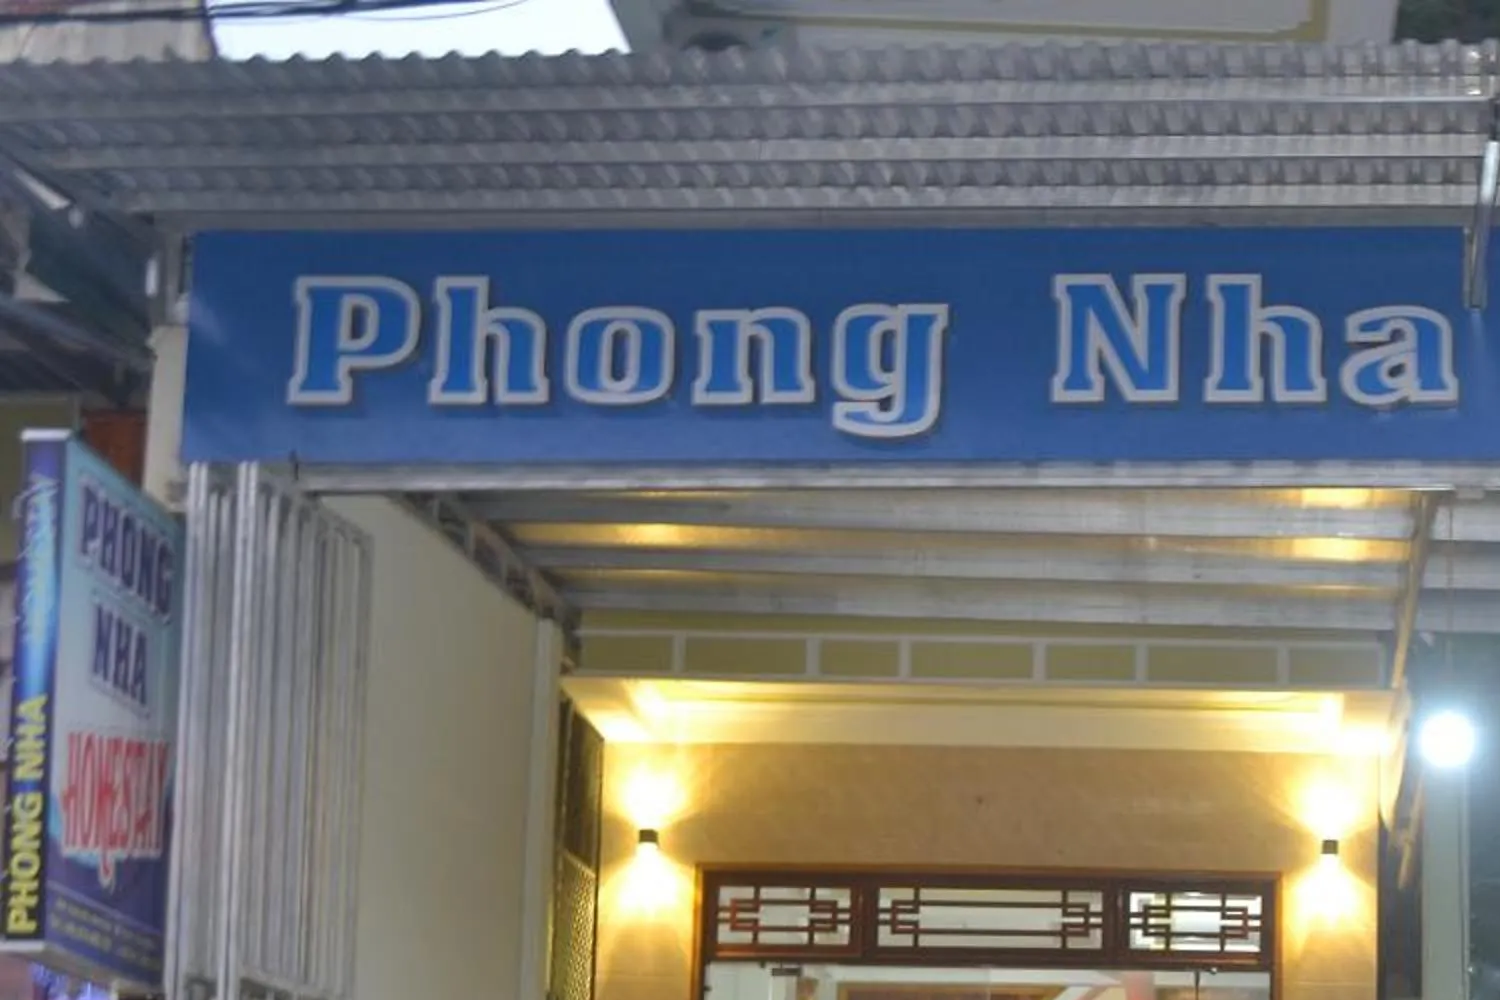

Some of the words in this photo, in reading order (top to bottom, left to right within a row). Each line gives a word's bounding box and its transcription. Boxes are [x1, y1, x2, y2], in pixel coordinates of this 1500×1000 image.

[286, 274, 948, 438] Phong
[1050, 273, 1459, 407] Nha
[78, 480, 173, 620] PHONG
[91, 599, 149, 707] NHA
[13, 694, 48, 780] NHA
[62, 729, 170, 884] HOMESTAY
[7, 792, 43, 934] PHONG
